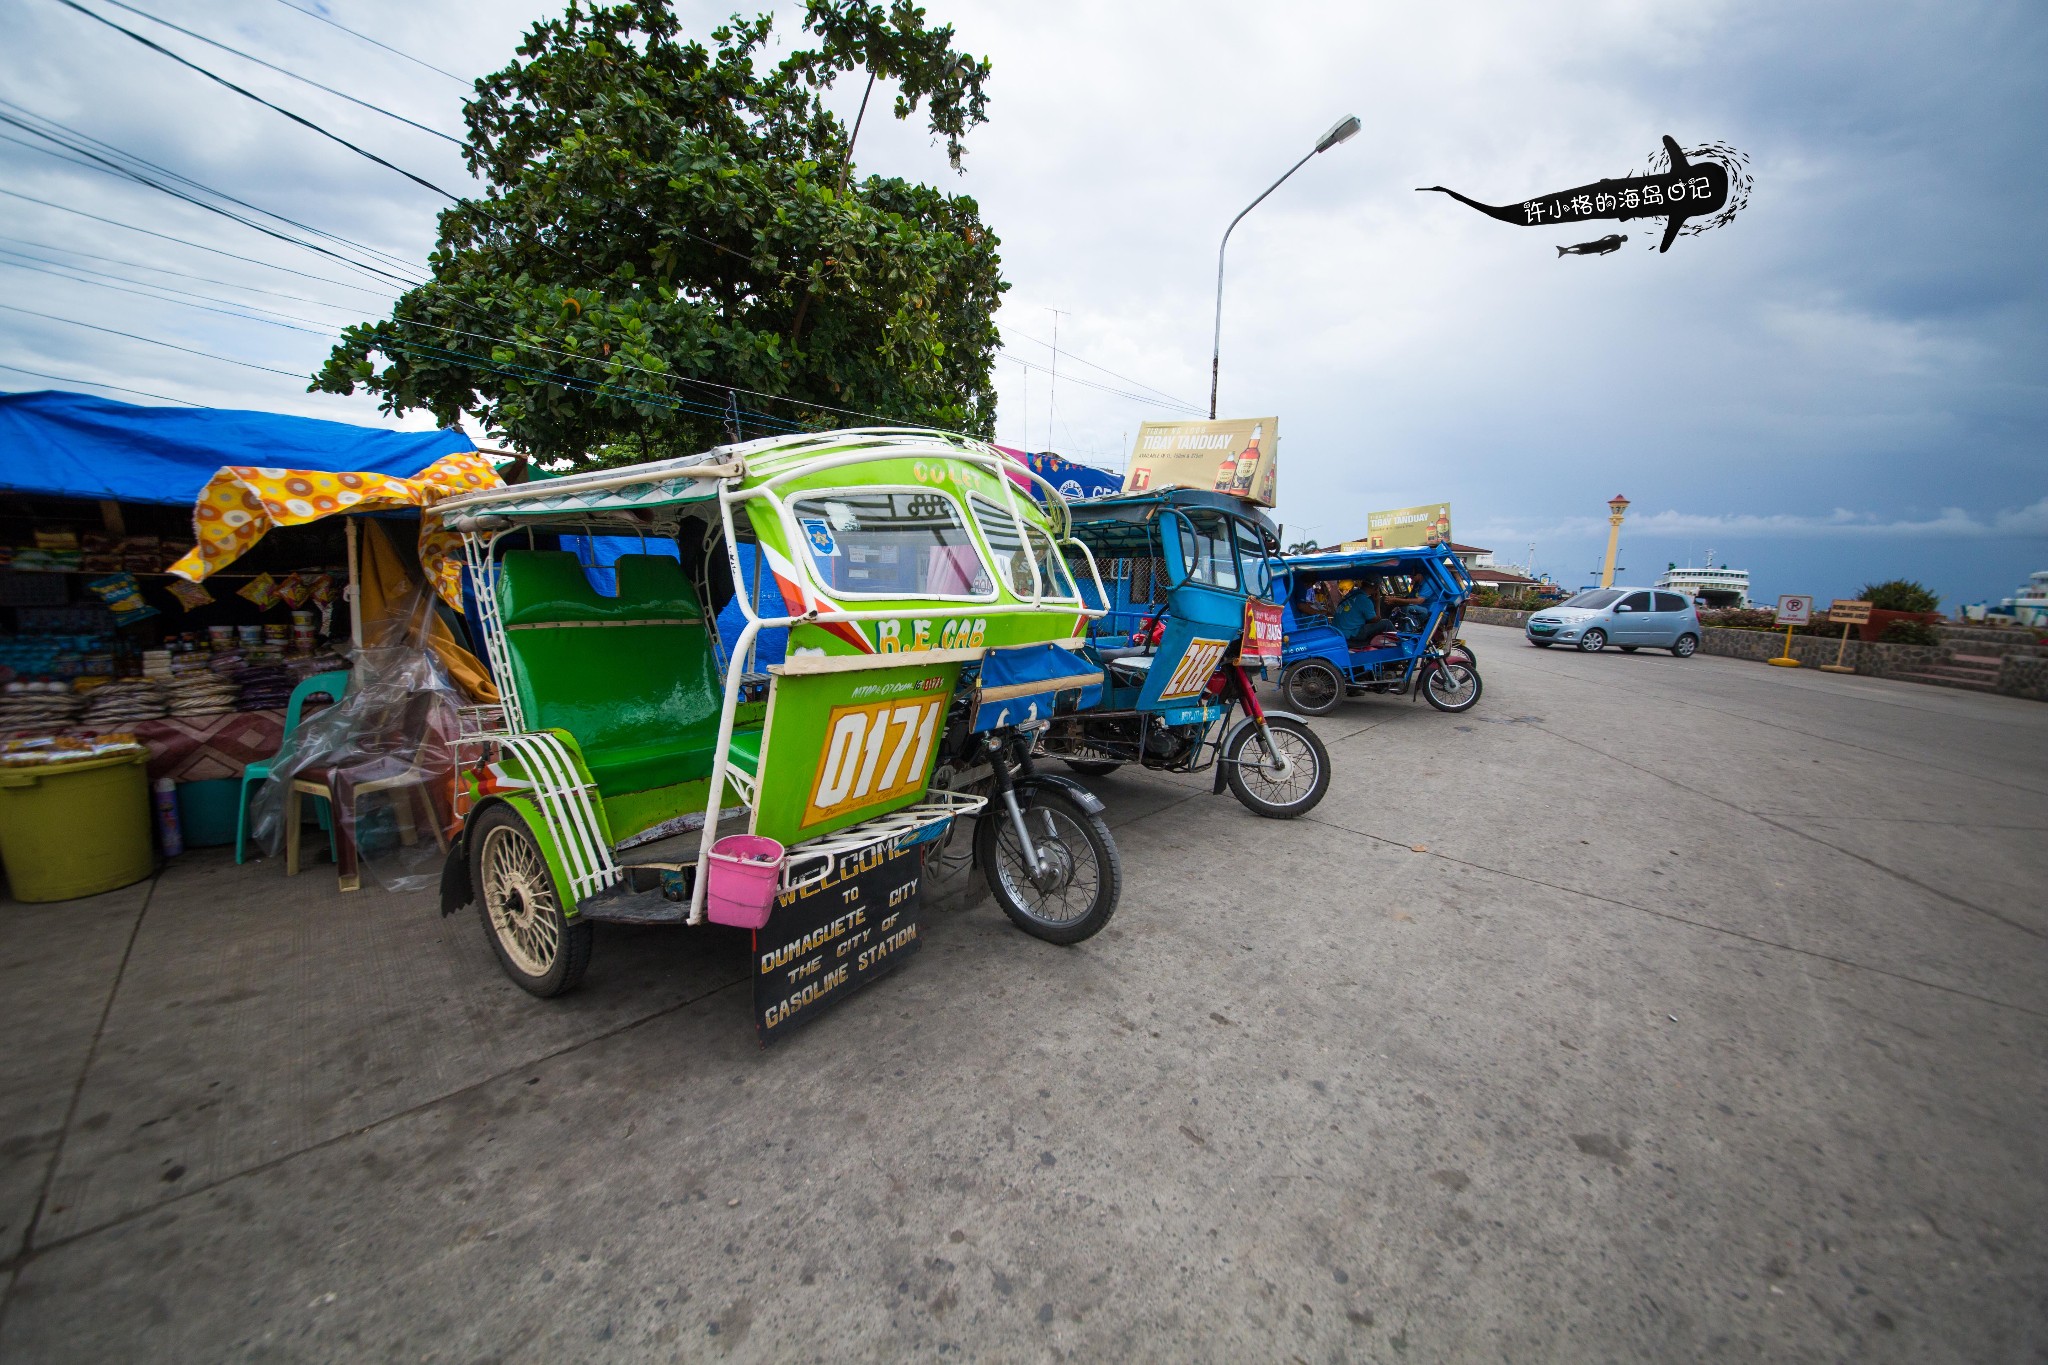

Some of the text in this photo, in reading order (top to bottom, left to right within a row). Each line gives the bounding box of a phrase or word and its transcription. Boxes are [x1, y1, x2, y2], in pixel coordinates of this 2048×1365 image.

[1142, 434, 1234, 450] TIBAY TANDUAY
[1163, 643, 1226, 696] 2182
[813, 701, 940, 808] 0171
[761, 878, 919, 975] DUMAGUETE CITY
[842, 886, 859, 904] TO
[765, 923, 917, 1029] GASOLINE STATION
[787, 911, 900, 984] THE CITY OF
